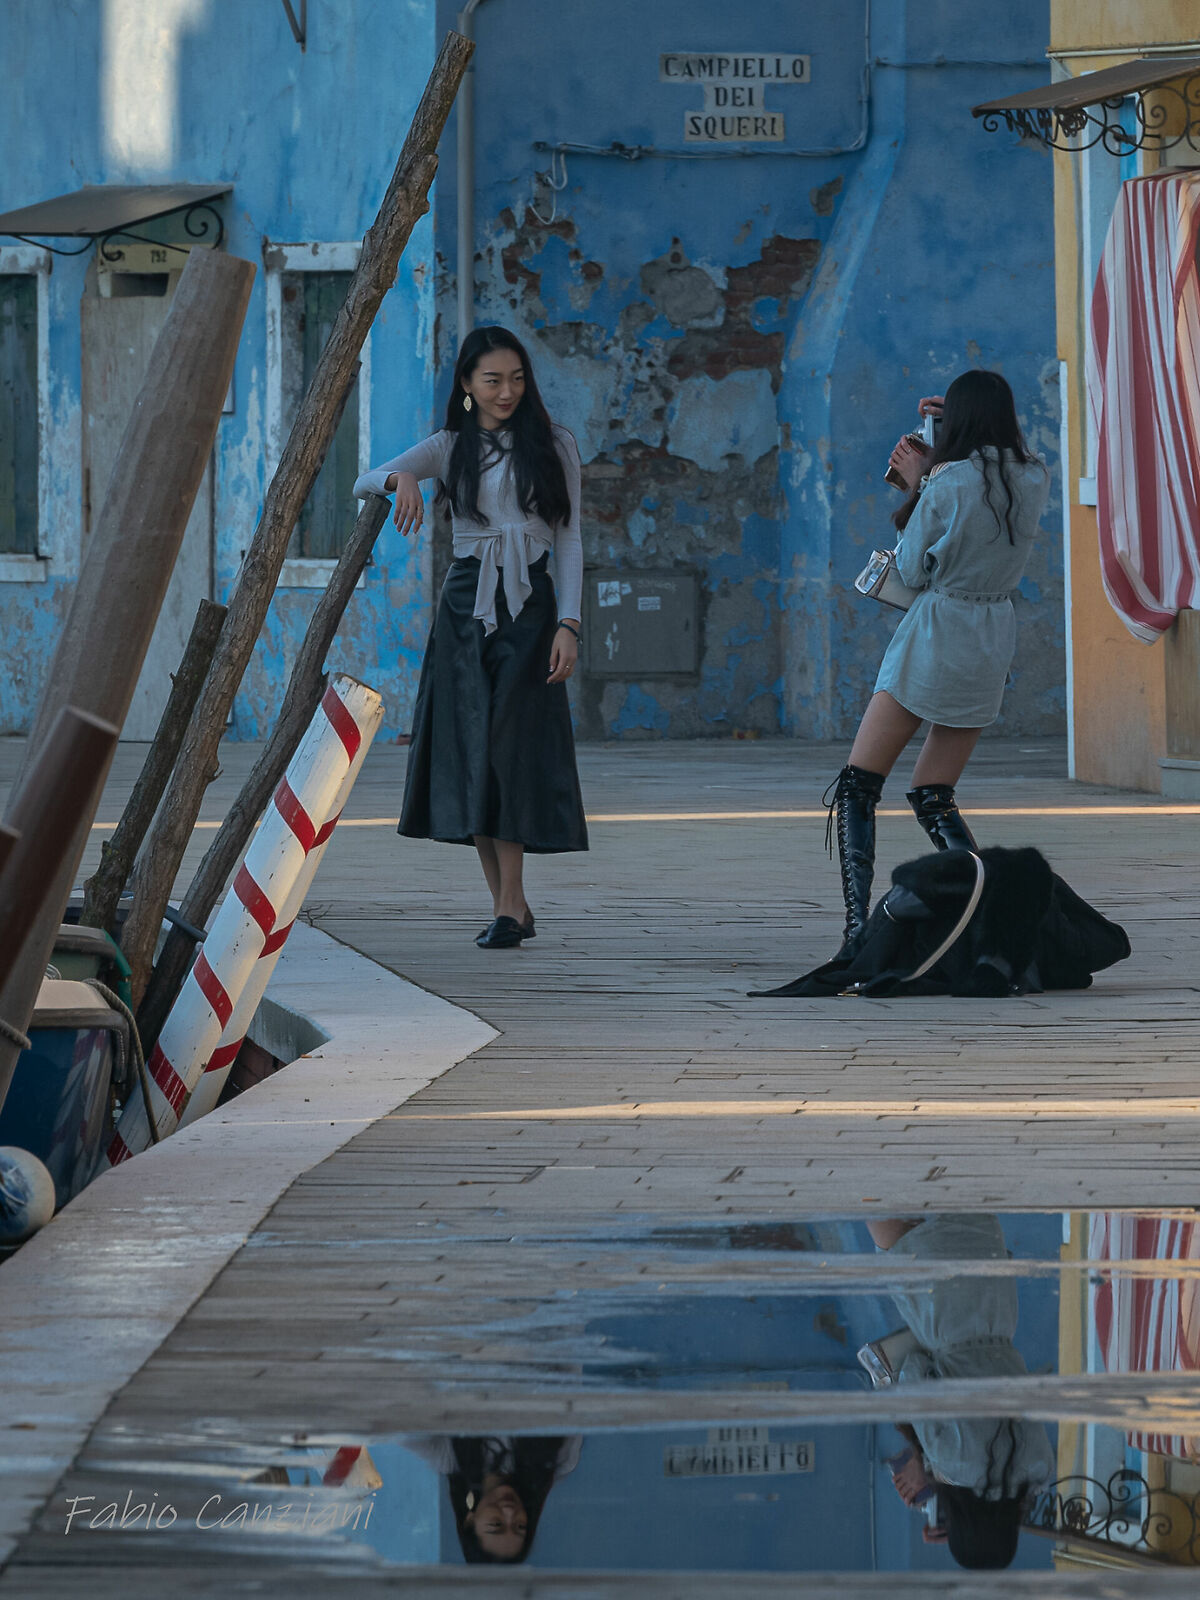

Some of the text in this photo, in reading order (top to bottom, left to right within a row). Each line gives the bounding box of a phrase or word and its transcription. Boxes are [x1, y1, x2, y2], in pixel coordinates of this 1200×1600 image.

[664, 57, 804, 78] CAMPIELLO
[714, 86, 755, 107] DEI
[688, 116, 777, 140] SQUERI
